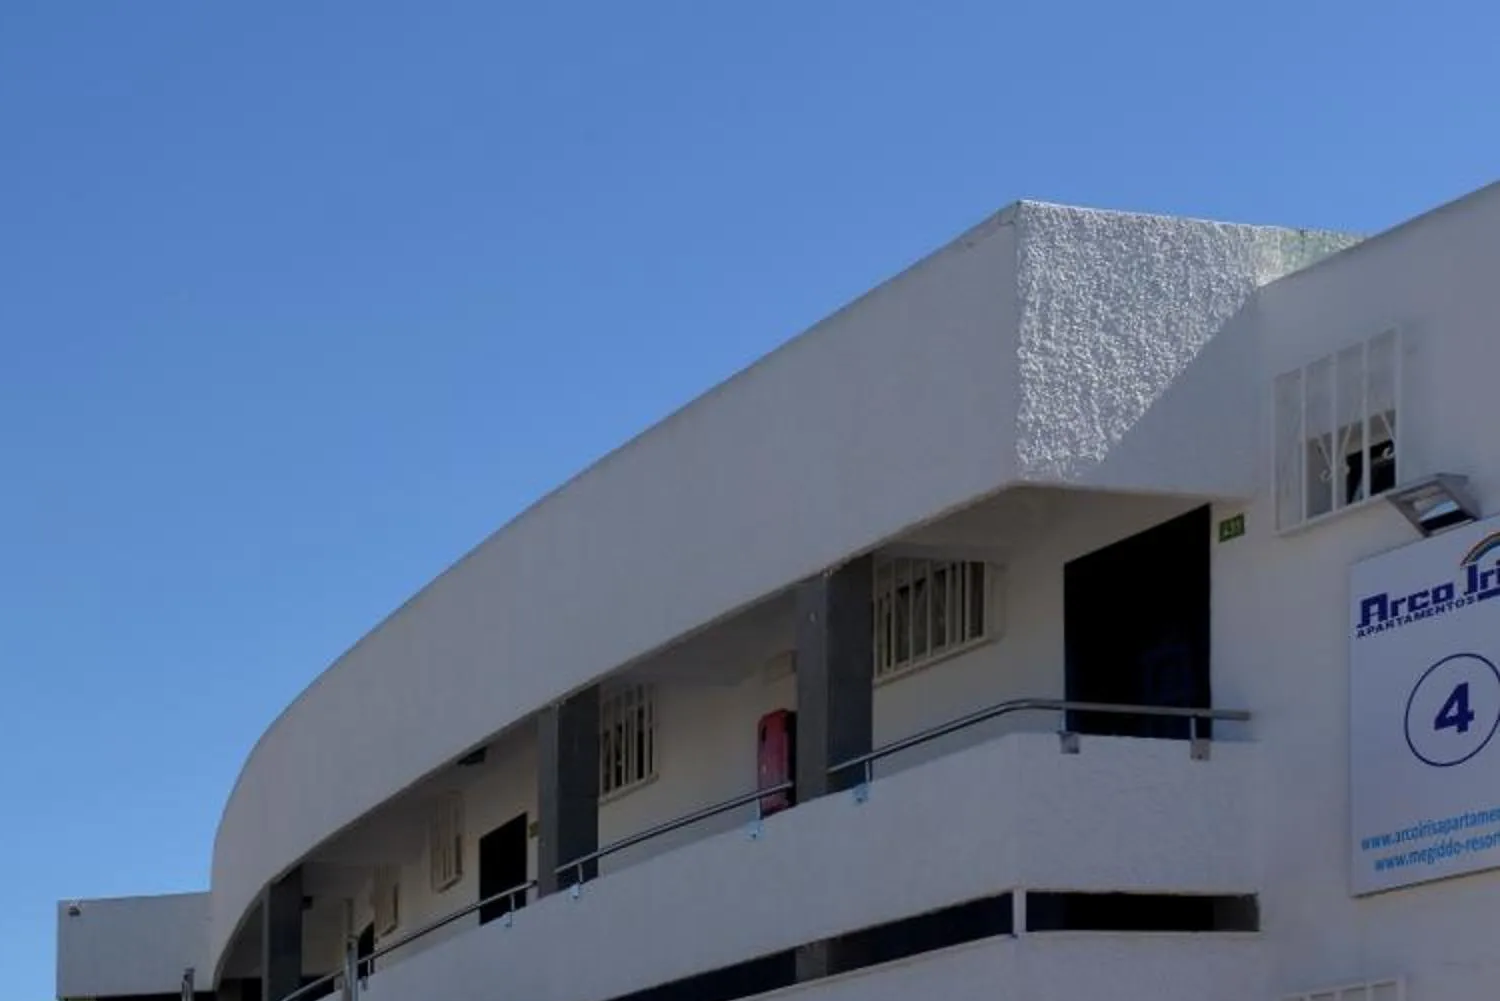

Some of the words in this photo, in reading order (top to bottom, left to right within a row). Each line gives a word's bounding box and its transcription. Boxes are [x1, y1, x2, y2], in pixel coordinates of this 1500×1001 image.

[1357, 581, 1455, 629] Arco
[1357, 595, 1475, 638] APARTAMENTOS
[1433, 682, 1474, 732] 4
[1361, 807, 1500, 850] www.arcoirisapartame
